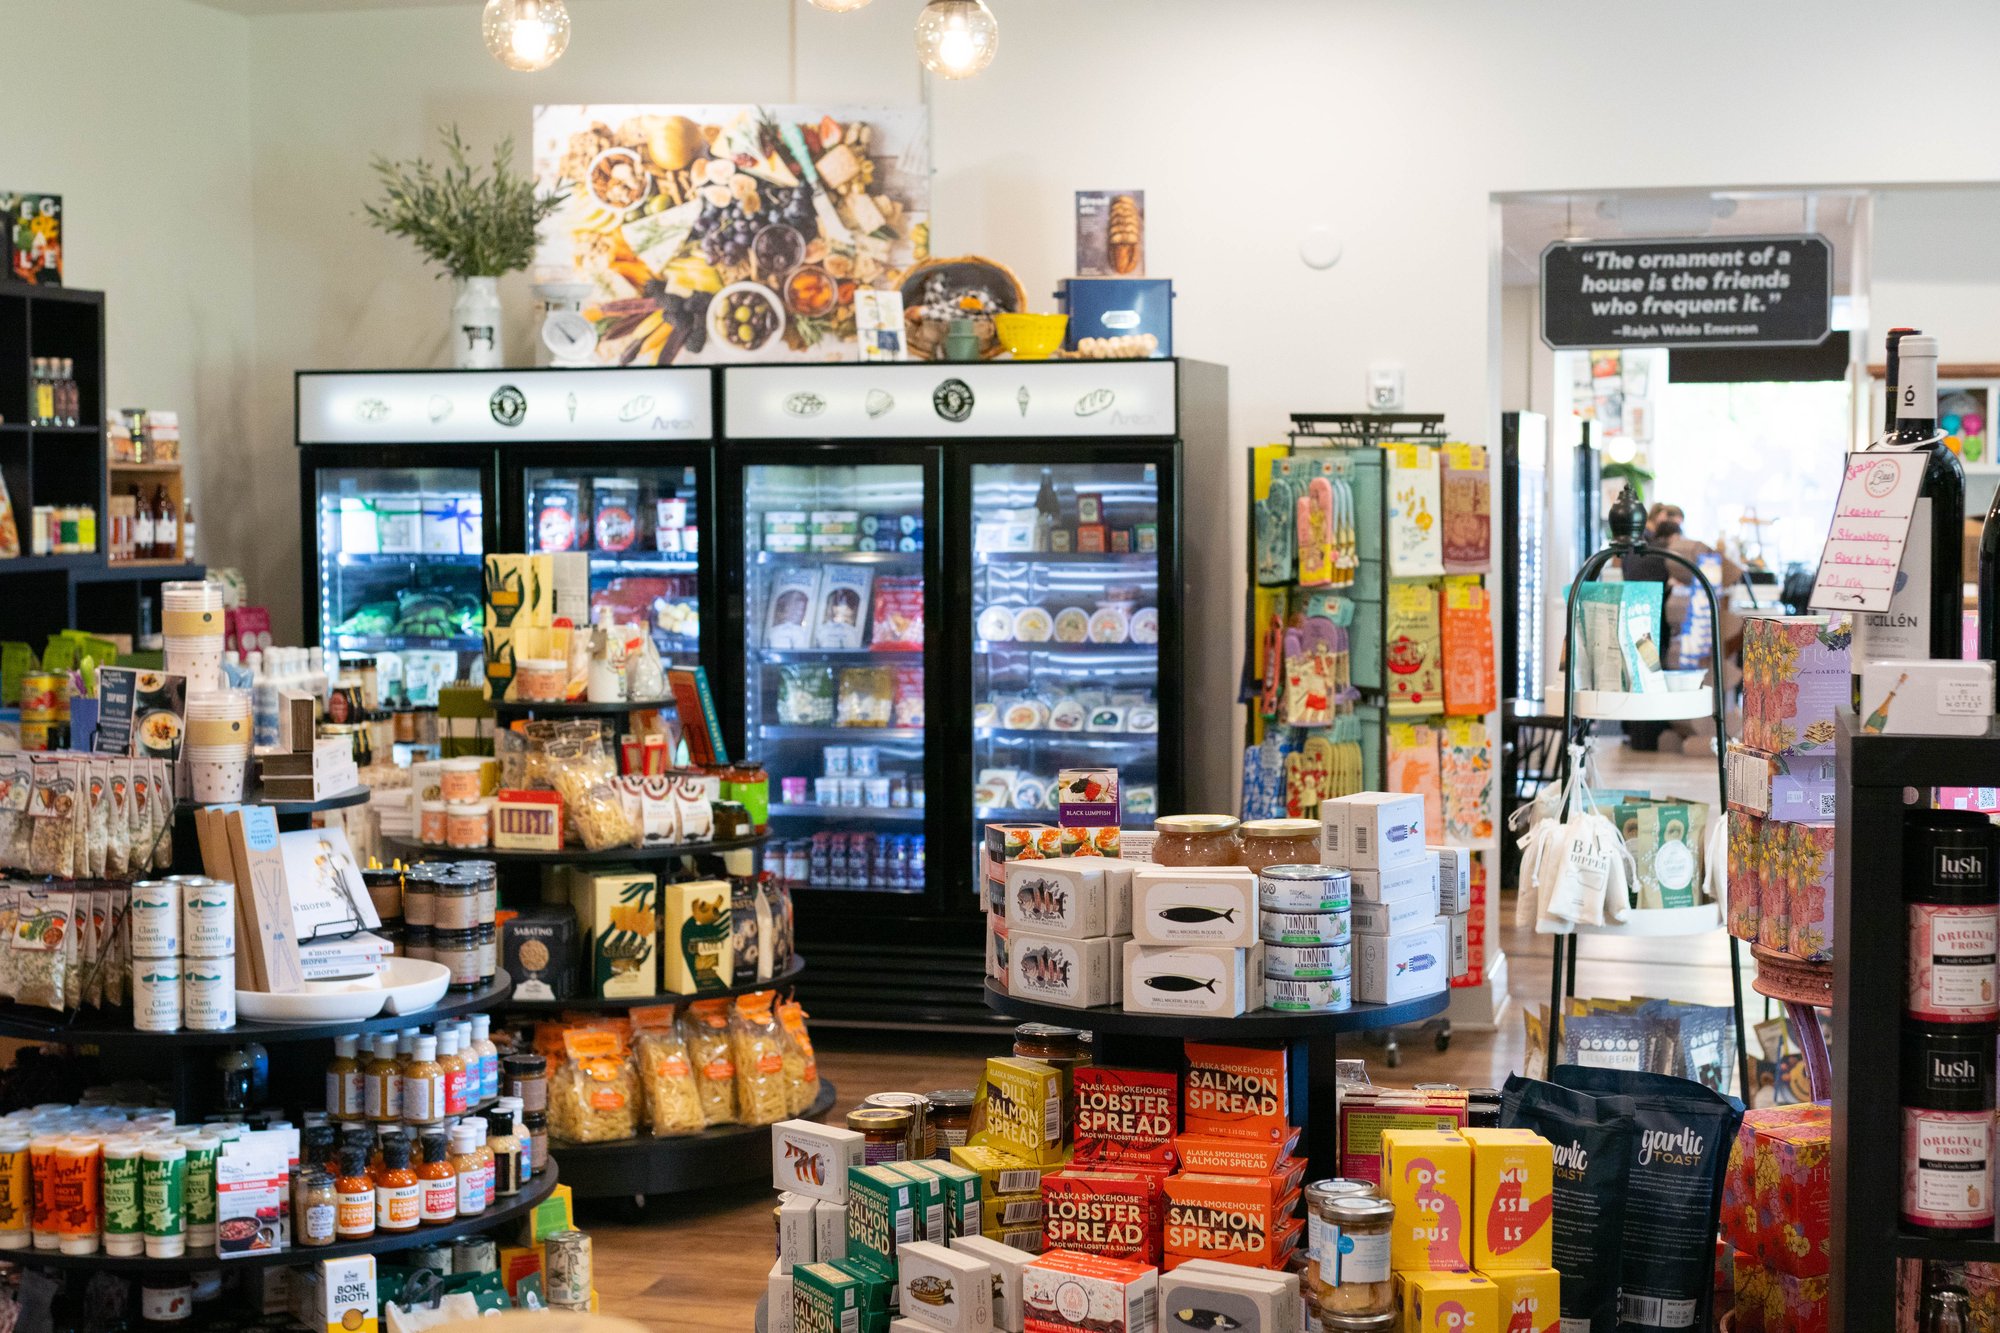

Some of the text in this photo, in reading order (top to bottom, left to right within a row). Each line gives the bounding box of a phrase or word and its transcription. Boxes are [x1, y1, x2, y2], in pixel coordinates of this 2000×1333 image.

[1638, 250, 1744, 269] ornament
[1749, 246, 1773, 266] of
[1777, 250, 1792, 265] a
[1581, 269, 1791, 293] house is the friends
[1591, 296, 1638, 316] who
[1641, 295, 1738, 318] frequent
[1660, 323, 1702, 337] Waldo
[1703, 323, 1759, 335] Emerson
[1844, 506, 1886, 518] Leather
[1837, 528, 1890, 550] Strawberry
[138, 926, 160, 934] Clam
[196, 926, 219, 934] Clam
[513, 927, 554, 937] SABATINO
[189, 934, 225, 943] Chowder
[152, 999, 174, 1007] Clam
[190, 998, 212, 1006] Clam
[1190, 1061, 1220, 1071] ALASKA
[1609, 1055, 1637, 1064] BEAN
[1080, 1083, 1111, 1092] ALASKA
[1190, 1070, 1277, 1096] SALMON
[1002, 1081, 1028, 1106] DILL
[1080, 1091, 1171, 1115] LOBSTER
[1189, 1089, 1278, 1117] SPREAD
[988, 1096, 1039, 1130] SALMON
[1079, 1110, 1171, 1136] SPREAD
[987, 1115, 1039, 1149] SPREAD
[1113, 1134, 1138, 1142] LOBSTER
[1144, 1136, 1170, 1144] SALMON
[1638, 1126, 1704, 1166] garlic
[1922, 1135, 1984, 1148] ORIGINAL
[1186, 1156, 1268, 1169] SALMON SPREAD
[1652, 1151, 1701, 1167] TOAST
[1417, 1169, 1447, 1184] OC
[1499, 1168, 1529, 1183] MU
[849, 1189, 889, 1216] PEPPER GARLIC
[1048, 1192, 1080, 1200] ALASKA
[1170, 1198, 1202, 1207] ALASKA
[1048, 1200, 1142, 1224] LOBSTER
[1418, 1198, 1445, 1213] TO
[1498, 1197, 1530, 1212] SSE
[849, 1200, 889, 1236] SALMON
[1169, 1207, 1265, 1231] SALMON
[849, 1219, 890, 1256] SPREAD
[1047, 1219, 1143, 1245] SPREAD
[1412, 1227, 1450, 1242] PUS
[1503, 1226, 1523, 1241] LS
[1067, 1241, 1083, 1249] WITH
[1169, 1227, 1265, 1253] SPREAD
[337, 1282, 366, 1295] BONE
[335, 1291, 370, 1304] BROTH
[794, 1286, 834, 1317] PEPPER GARLIC
[1511, 1297, 1540, 1314] MU
[793, 1297, 834, 1333] SALMON
[1446, 1311, 1476, 1327] OC
